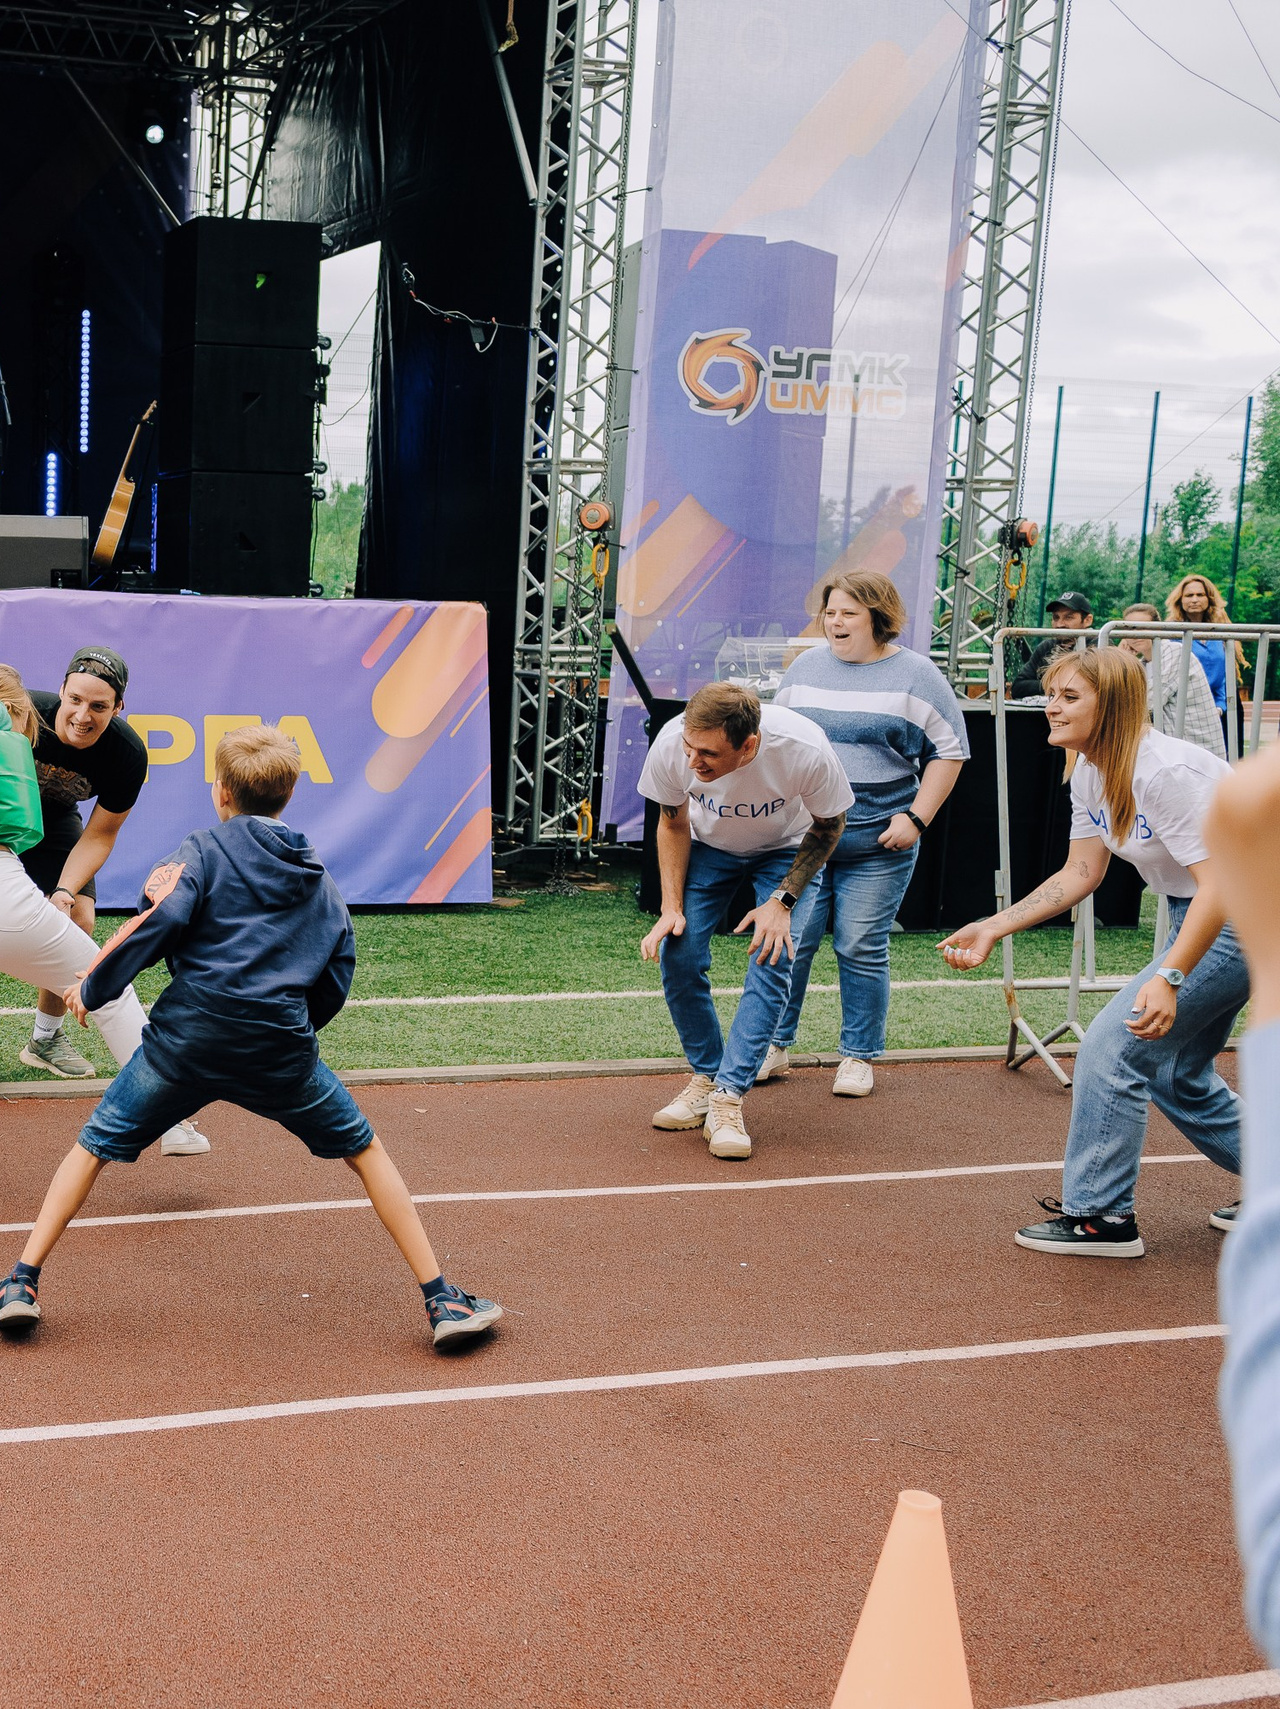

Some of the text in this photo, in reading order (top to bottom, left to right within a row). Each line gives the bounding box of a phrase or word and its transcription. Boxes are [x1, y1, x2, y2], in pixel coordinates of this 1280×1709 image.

[771, 350, 903, 386] УГМК
[770, 382, 903, 414] UMMC
[688, 791, 786, 818] МАССИВ
